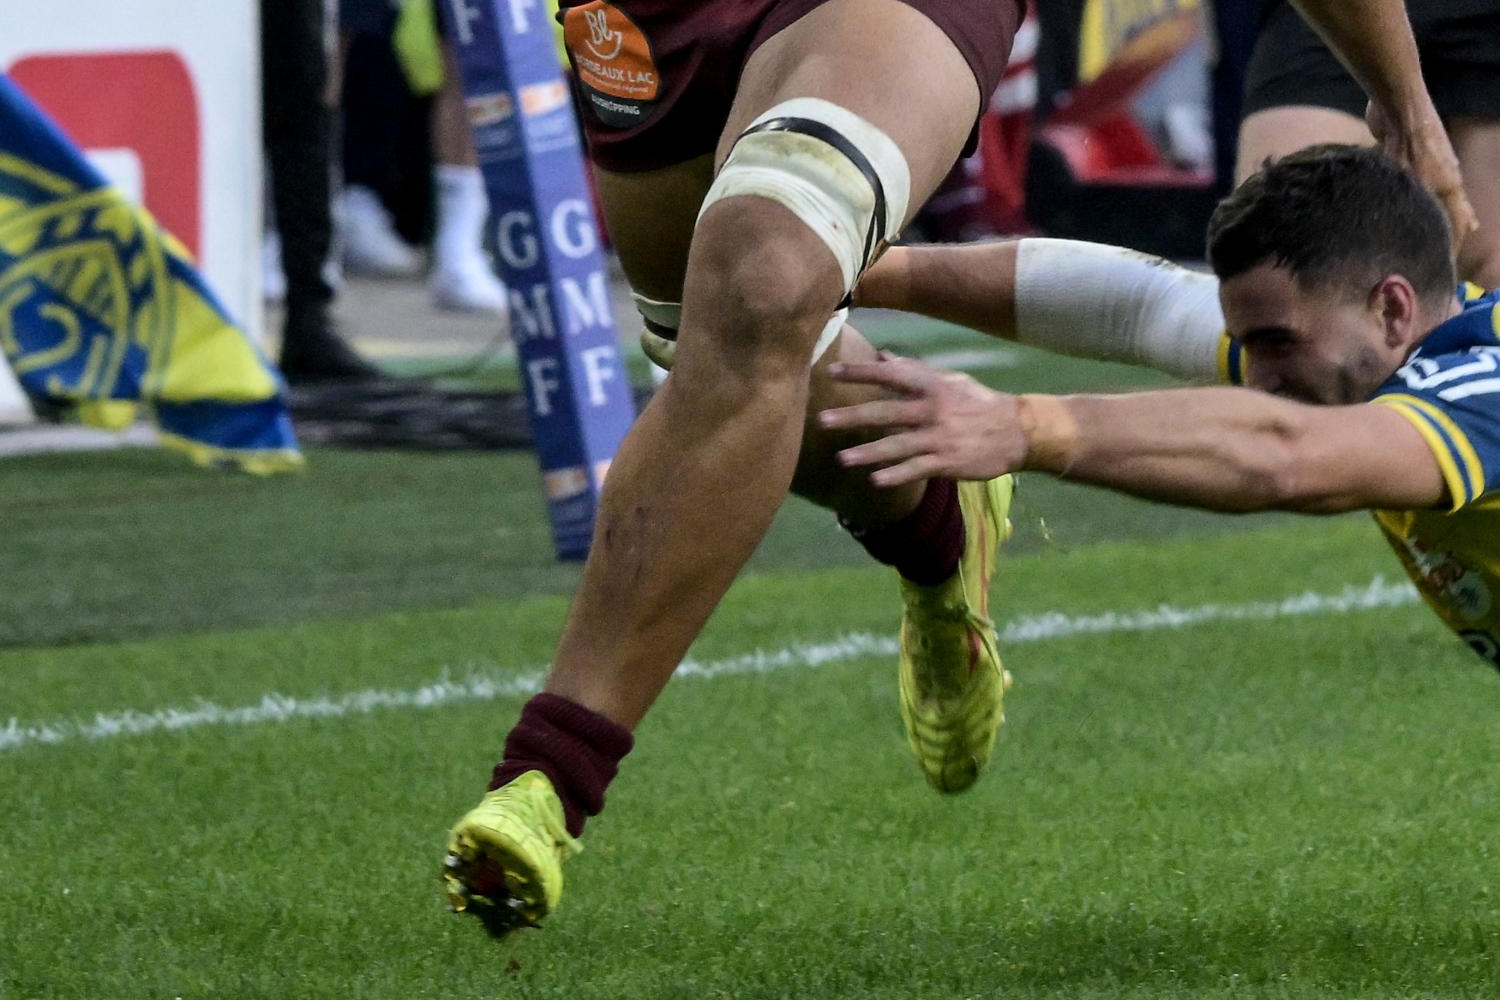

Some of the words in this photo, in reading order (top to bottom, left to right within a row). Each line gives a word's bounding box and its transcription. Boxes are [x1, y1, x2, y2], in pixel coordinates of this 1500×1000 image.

[627, 70, 655, 85] LAC
[497, 211, 561, 418] GMF
[551, 199, 617, 408] GMF
